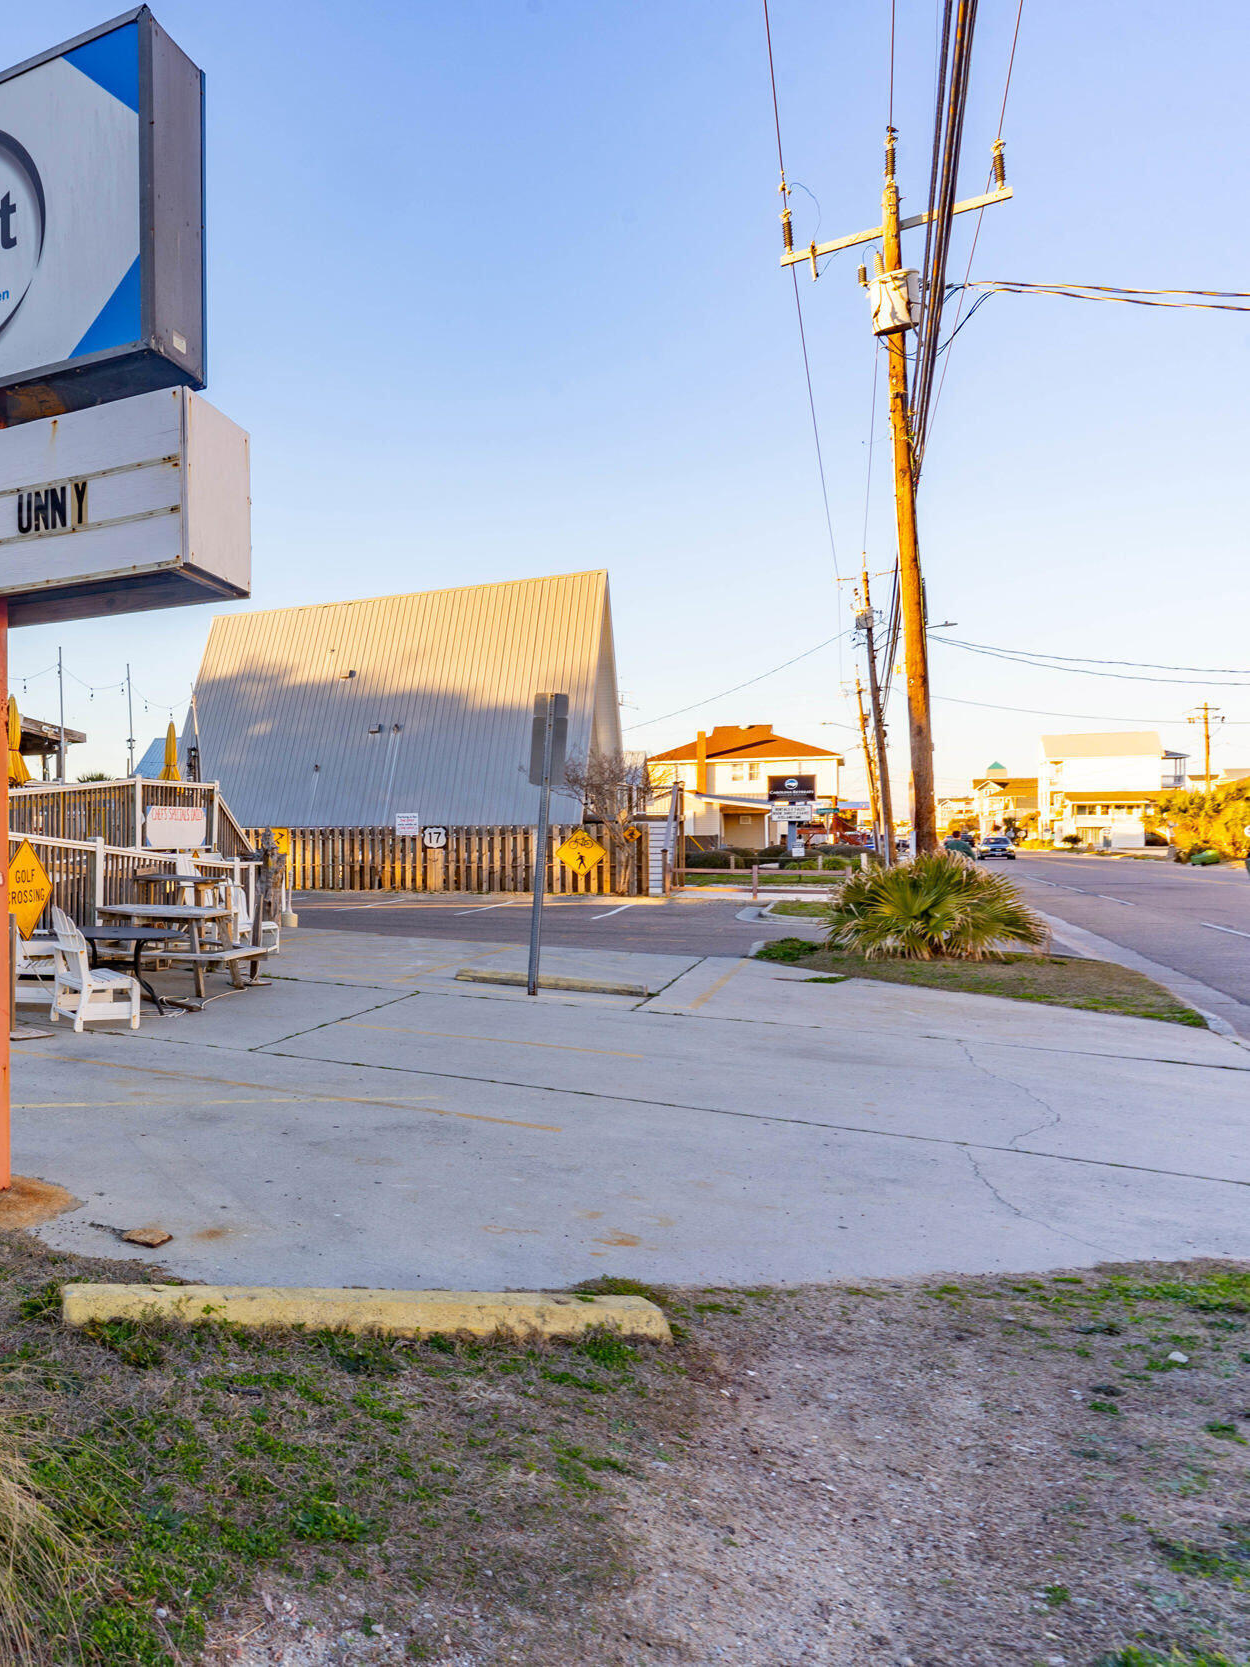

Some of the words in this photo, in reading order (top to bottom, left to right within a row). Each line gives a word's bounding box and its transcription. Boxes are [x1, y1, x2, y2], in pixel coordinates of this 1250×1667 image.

[17, 481, 88, 534] UNNY
[428, 831, 442, 844] 17
[15, 868, 36, 884] GOLF
[9, 887, 45, 905] ROSSING
